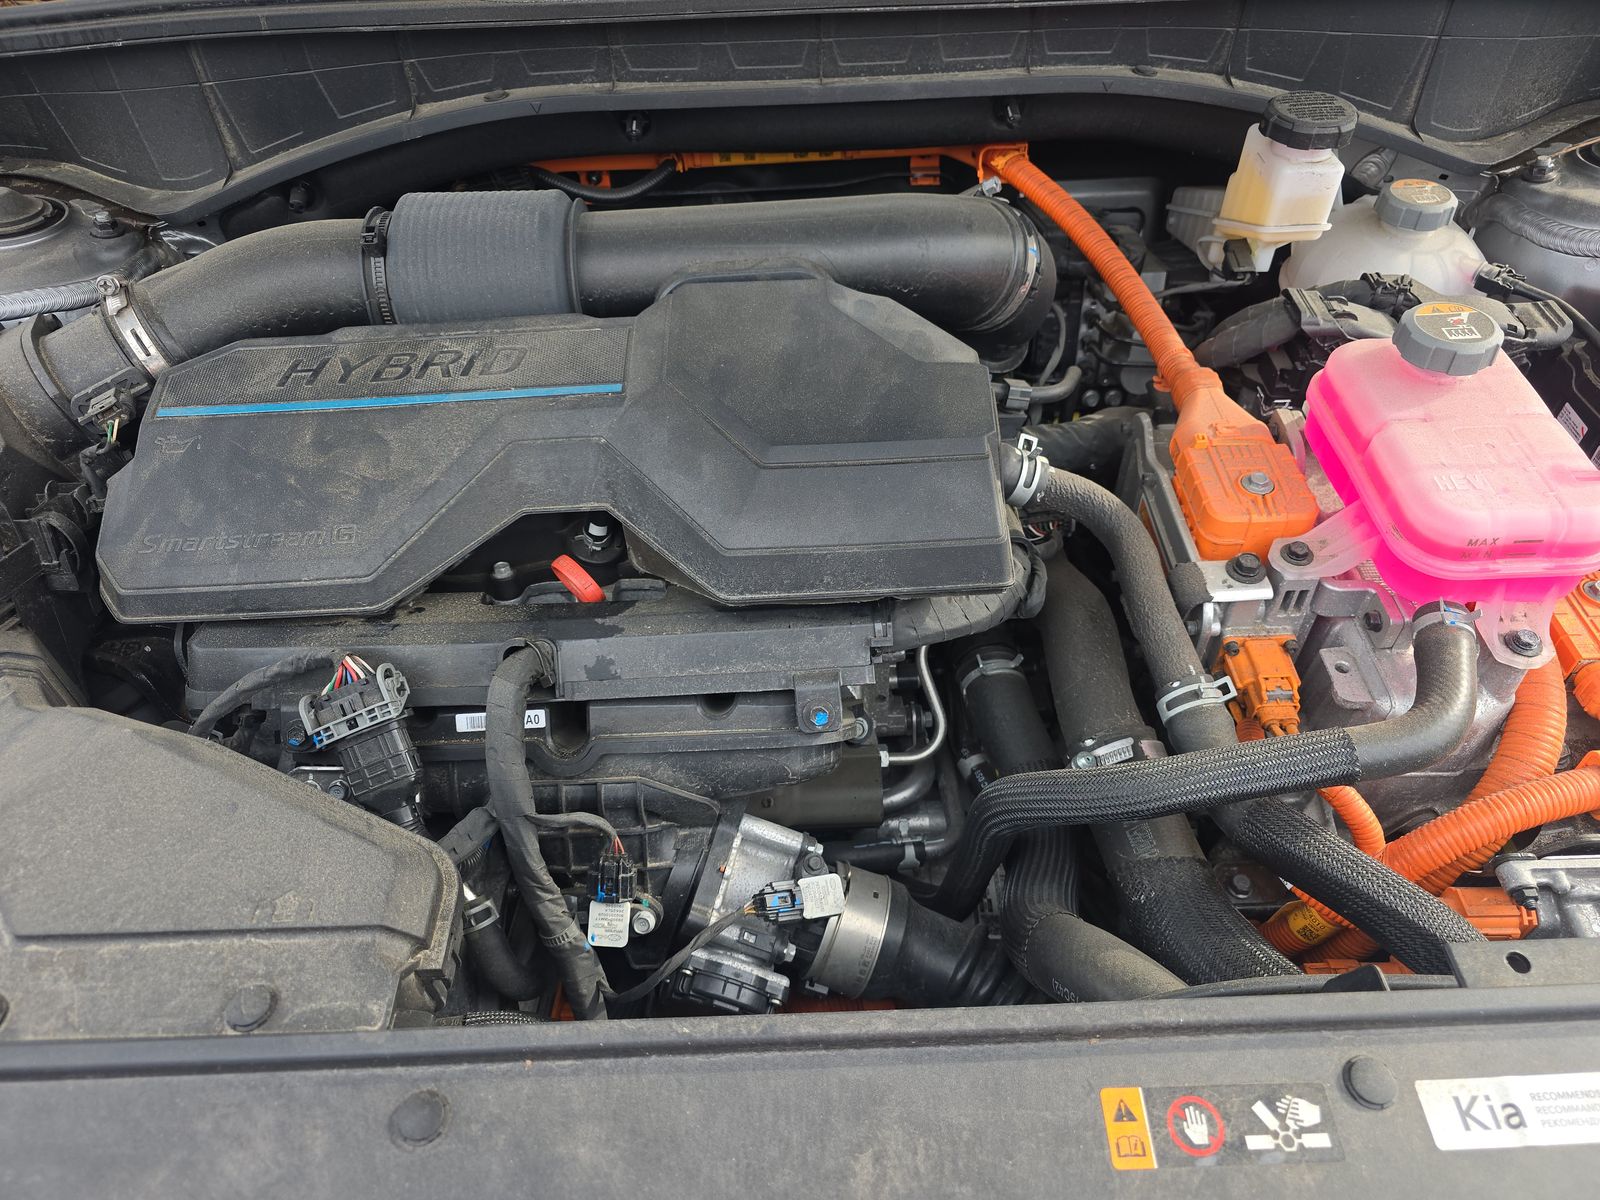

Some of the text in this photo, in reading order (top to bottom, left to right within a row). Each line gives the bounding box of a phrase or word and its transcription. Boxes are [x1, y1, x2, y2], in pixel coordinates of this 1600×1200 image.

[277, 346, 529, 389] HYBRID
[138, 527, 326, 554] Smartstream
[1467, 538, 1500, 547] MAX
[1461, 550, 1494, 559] MIN
[1452, 1094, 1528, 1132] Kia
